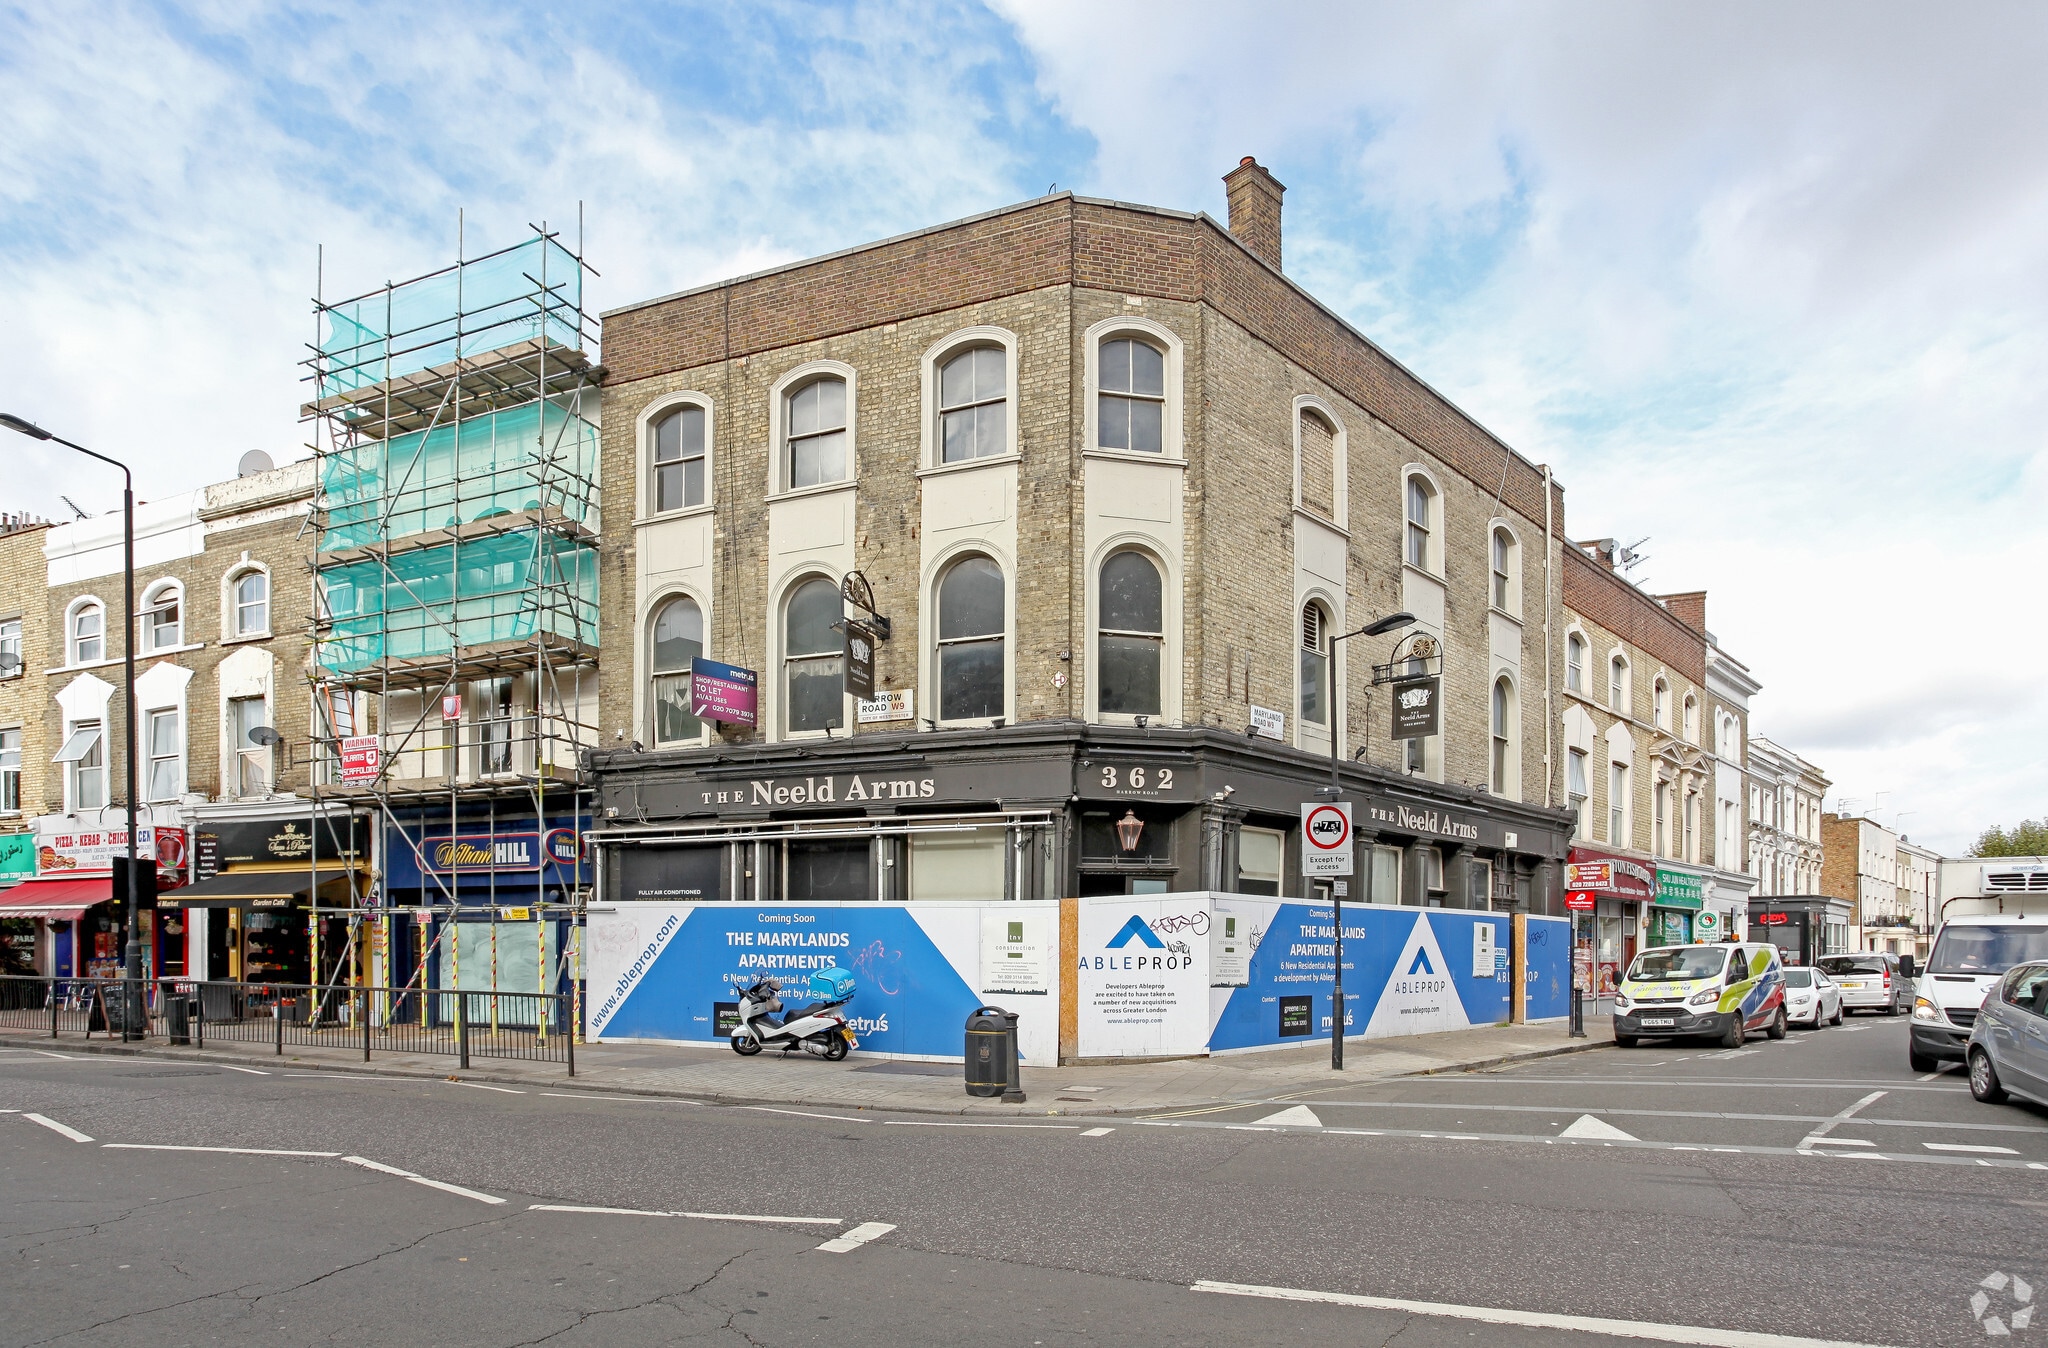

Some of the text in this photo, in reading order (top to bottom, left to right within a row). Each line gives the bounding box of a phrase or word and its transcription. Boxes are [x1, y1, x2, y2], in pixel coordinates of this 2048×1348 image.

[696, 676, 748, 692] SHOP/RESTAURANT
[696, 684, 722, 695] TO LET
[862, 704, 886, 712] ROAD
[1254, 708, 1282, 722] MARYLANDS
[1254, 717, 1266, 726] ROAD
[344, 736, 377, 748] WARNING
[344, 766, 378, 776] SCAFFOLDING
[702, 774, 934, 806] THE Neeld Arms
[1371, 806, 1478, 840] THE Neeld Arms
[55, 836, 73, 848] PIZZA
[80, 834, 100, 846] KEBAB
[108, 832, 128, 844] CHICK
[138, 830, 150, 842] CEN
[434, 842, 530, 868] William HILL
[556, 845, 576, 858] HILL
[1678, 876, 1701, 887] HEALTHCARE
[758, 913, 815, 924] Coming Soon
[1309, 909, 1328, 919] Coming
[1300, 925, 1365, 939] THE MARLANDS
[726, 932, 849, 947] THE MARYLANDS
[1290, 944, 1344, 956] APARTMENS
[738, 955, 836, 969] APARTMENTS
[1078, 956, 1192, 970] ABLEPROP
[1298, 961, 1325, 970] Residential
[1326, 962, 1354, 970] Apaments
[591, 914, 678, 1029] www.ableprop.com
[1497, 972, 1538, 982] ABLOP
[722, 974, 728, 983] 6
[730, 974, 748, 983] New
[752, 974, 799, 984] Redential
[1279, 974, 1311, 983] development
[1320, 973, 1336, 982] Ablepr
[1395, 980, 1445, 994] ABLEPROP
[791, 988, 803, 999] by
[1400, 1006, 1439, 1014] www.ableprop.com
[848, 1014, 888, 1035] etrus
